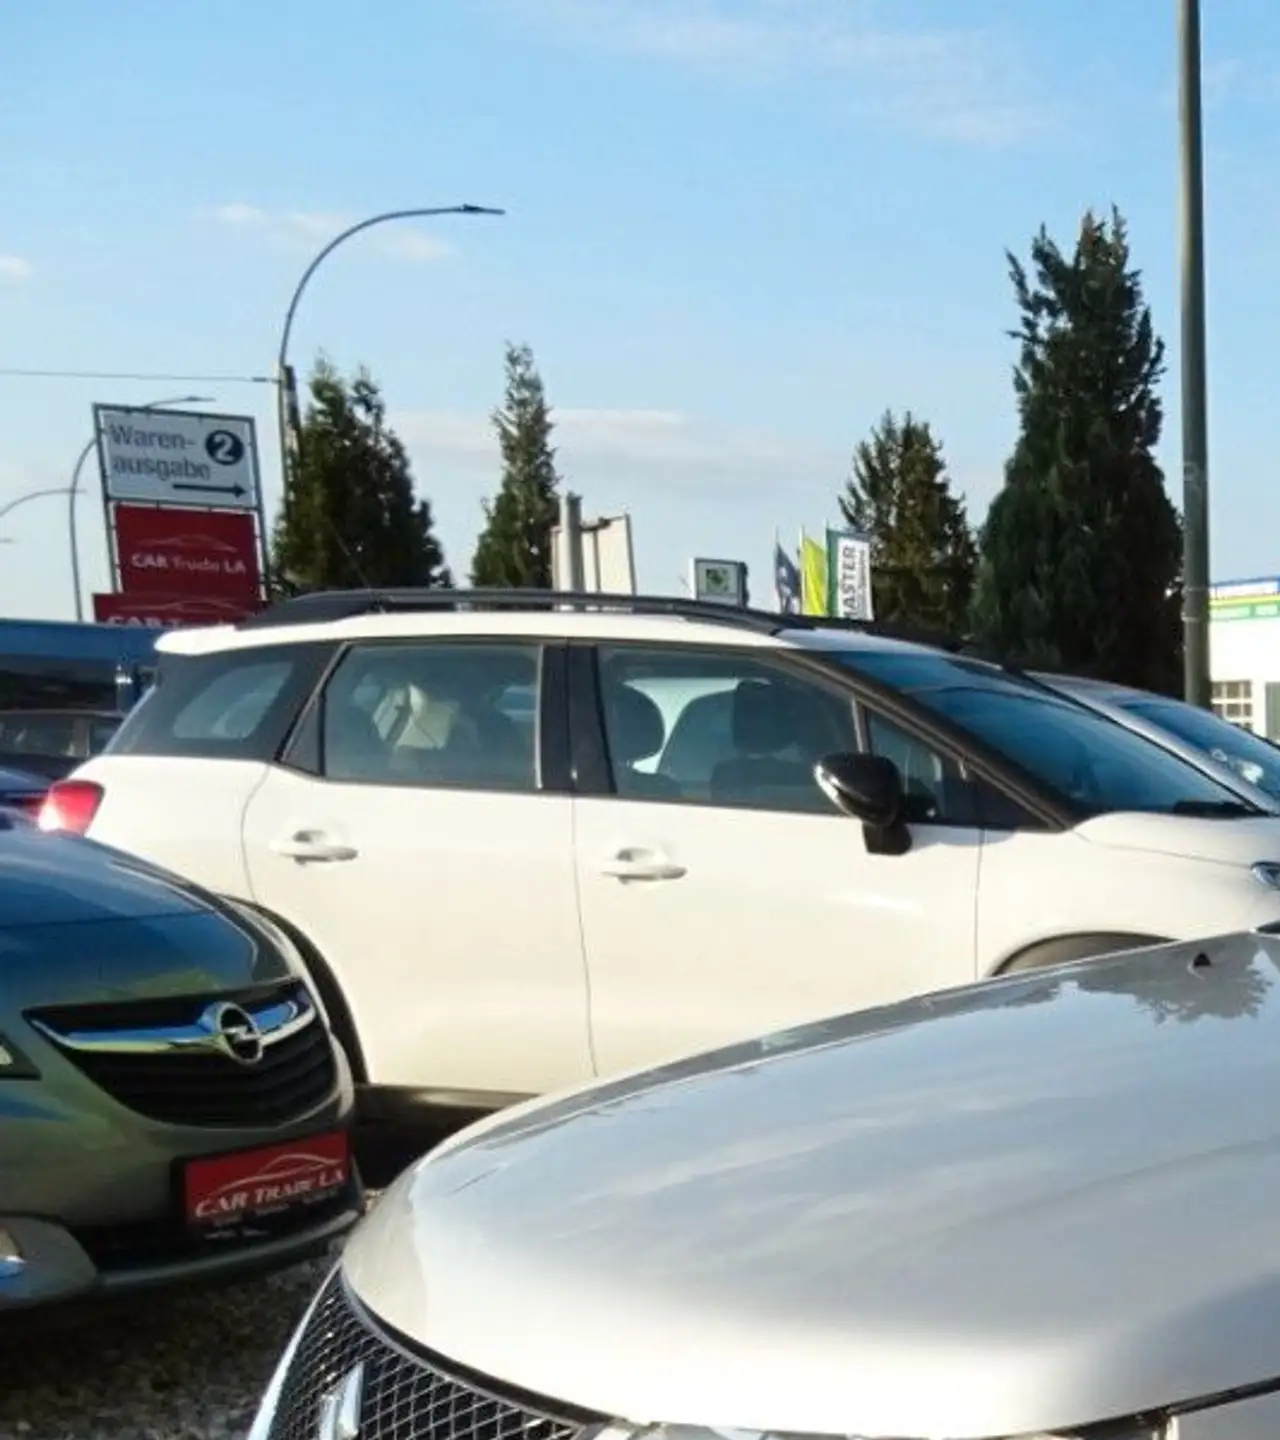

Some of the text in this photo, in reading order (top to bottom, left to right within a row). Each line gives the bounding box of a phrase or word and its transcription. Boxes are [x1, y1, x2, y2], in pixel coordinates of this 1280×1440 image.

[109, 423, 197, 450] Waren-
[211, 432, 236, 463] 2
[112, 456, 211, 481] ausgabe
[132, 552, 168, 569] CAR
[195, 1192, 248, 1217] CAR
